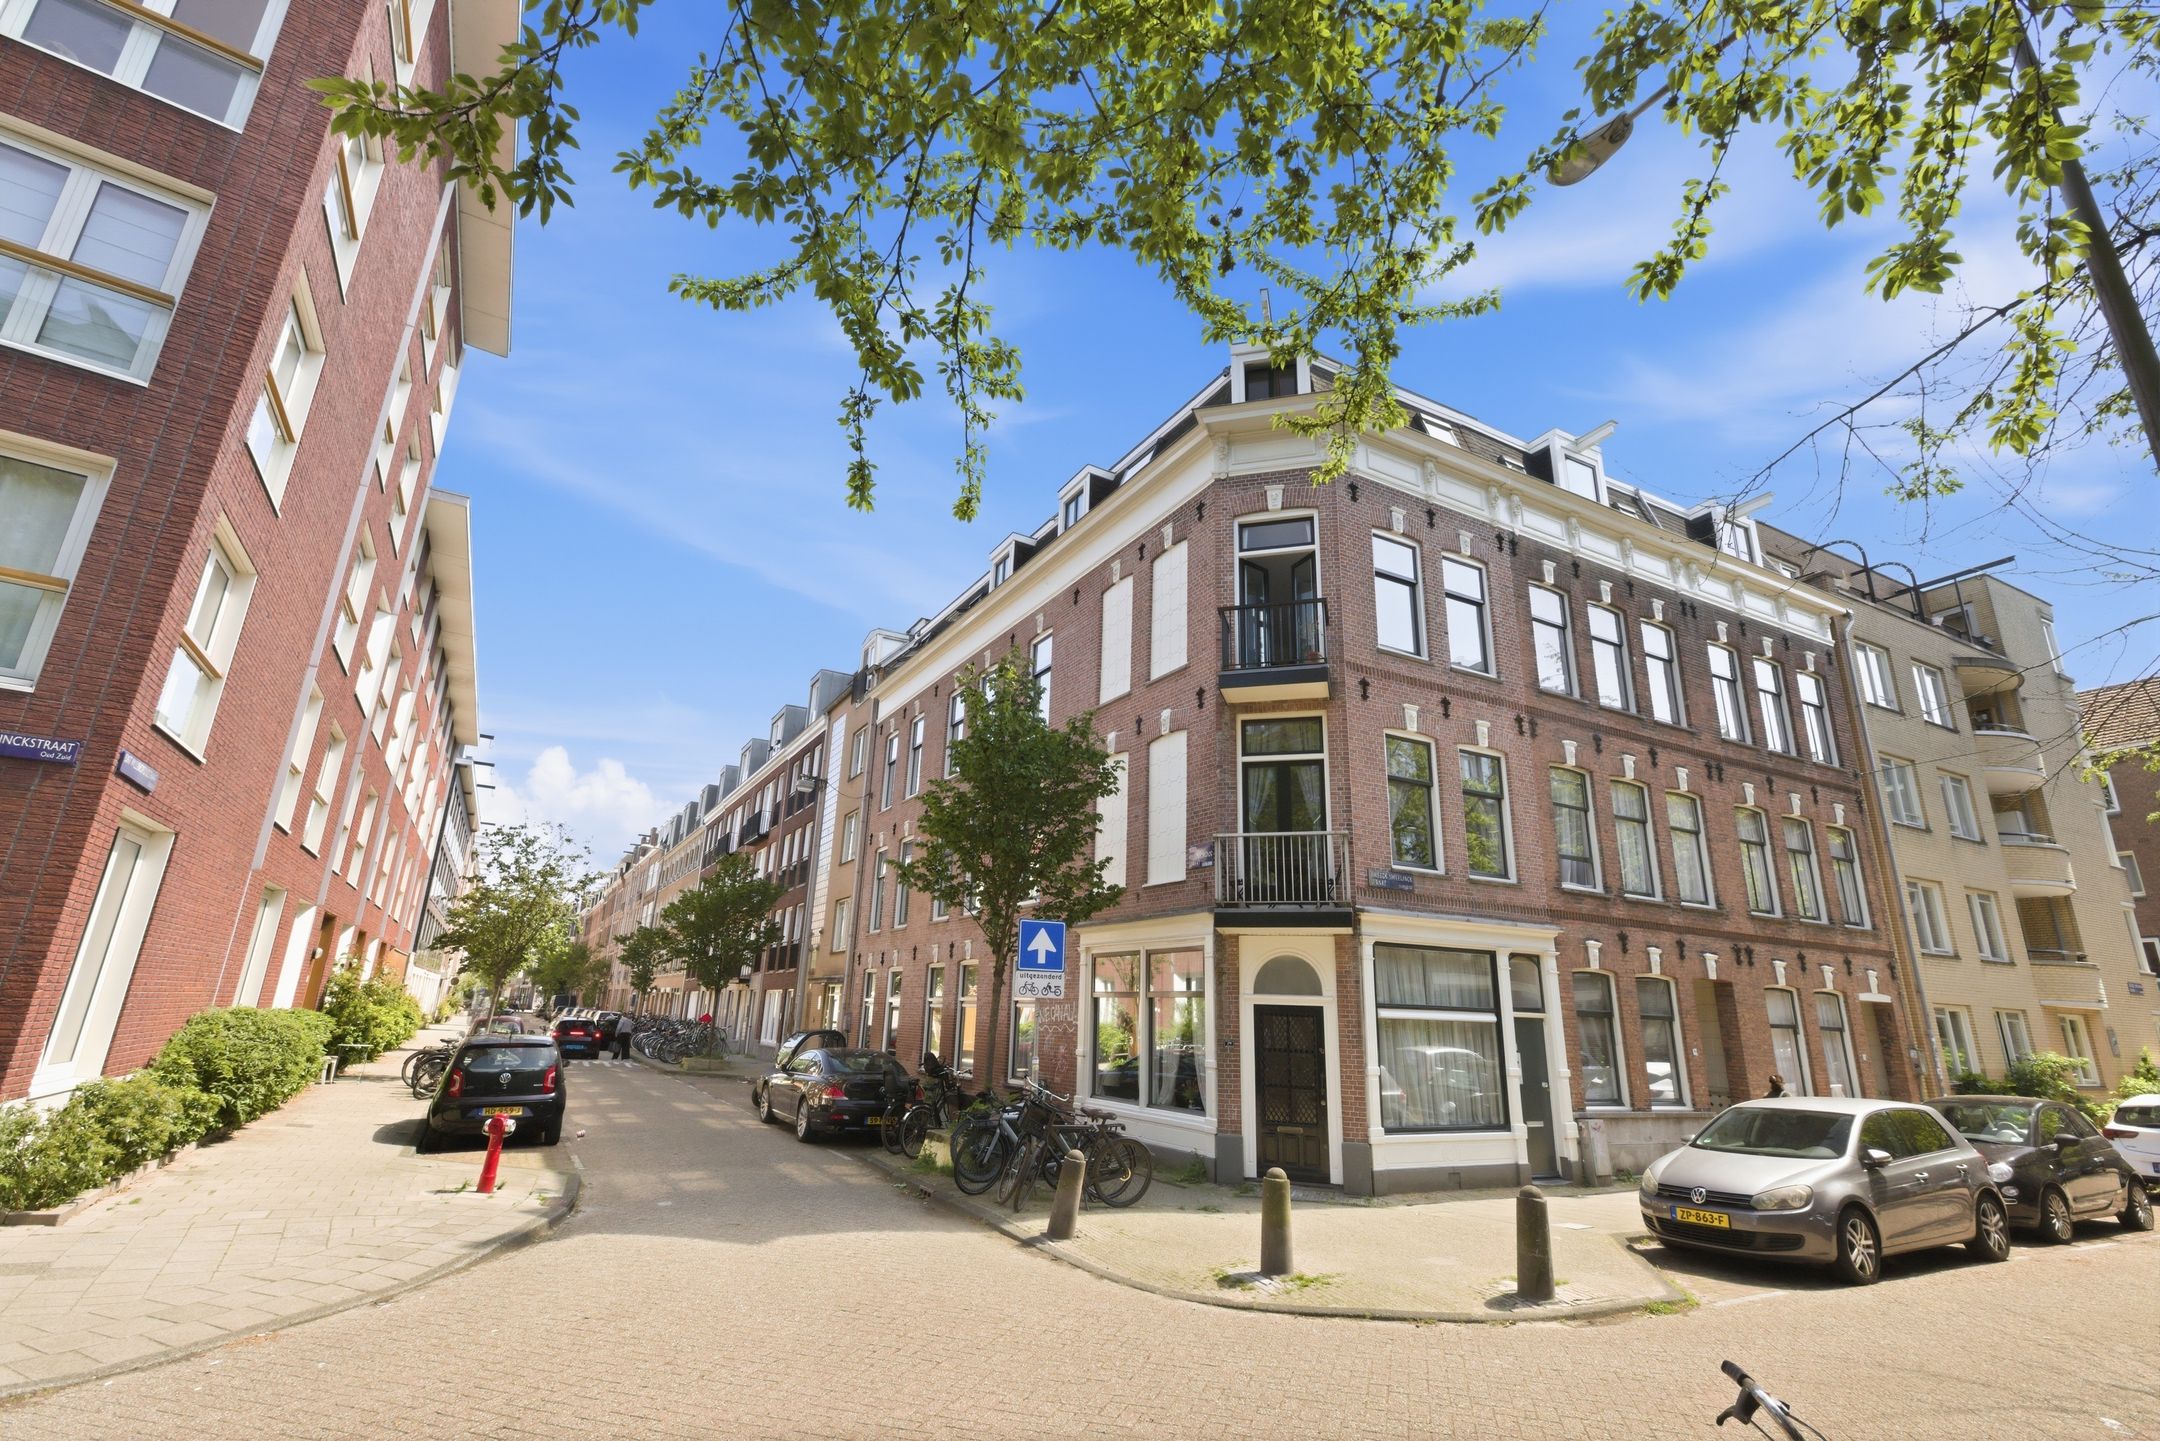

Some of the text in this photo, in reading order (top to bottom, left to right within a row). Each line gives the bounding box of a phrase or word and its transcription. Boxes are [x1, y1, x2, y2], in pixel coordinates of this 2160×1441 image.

[40, 750, 72, 761] Oud Zuid
[1680, 1209, 1724, 1224] ZP-863-F
